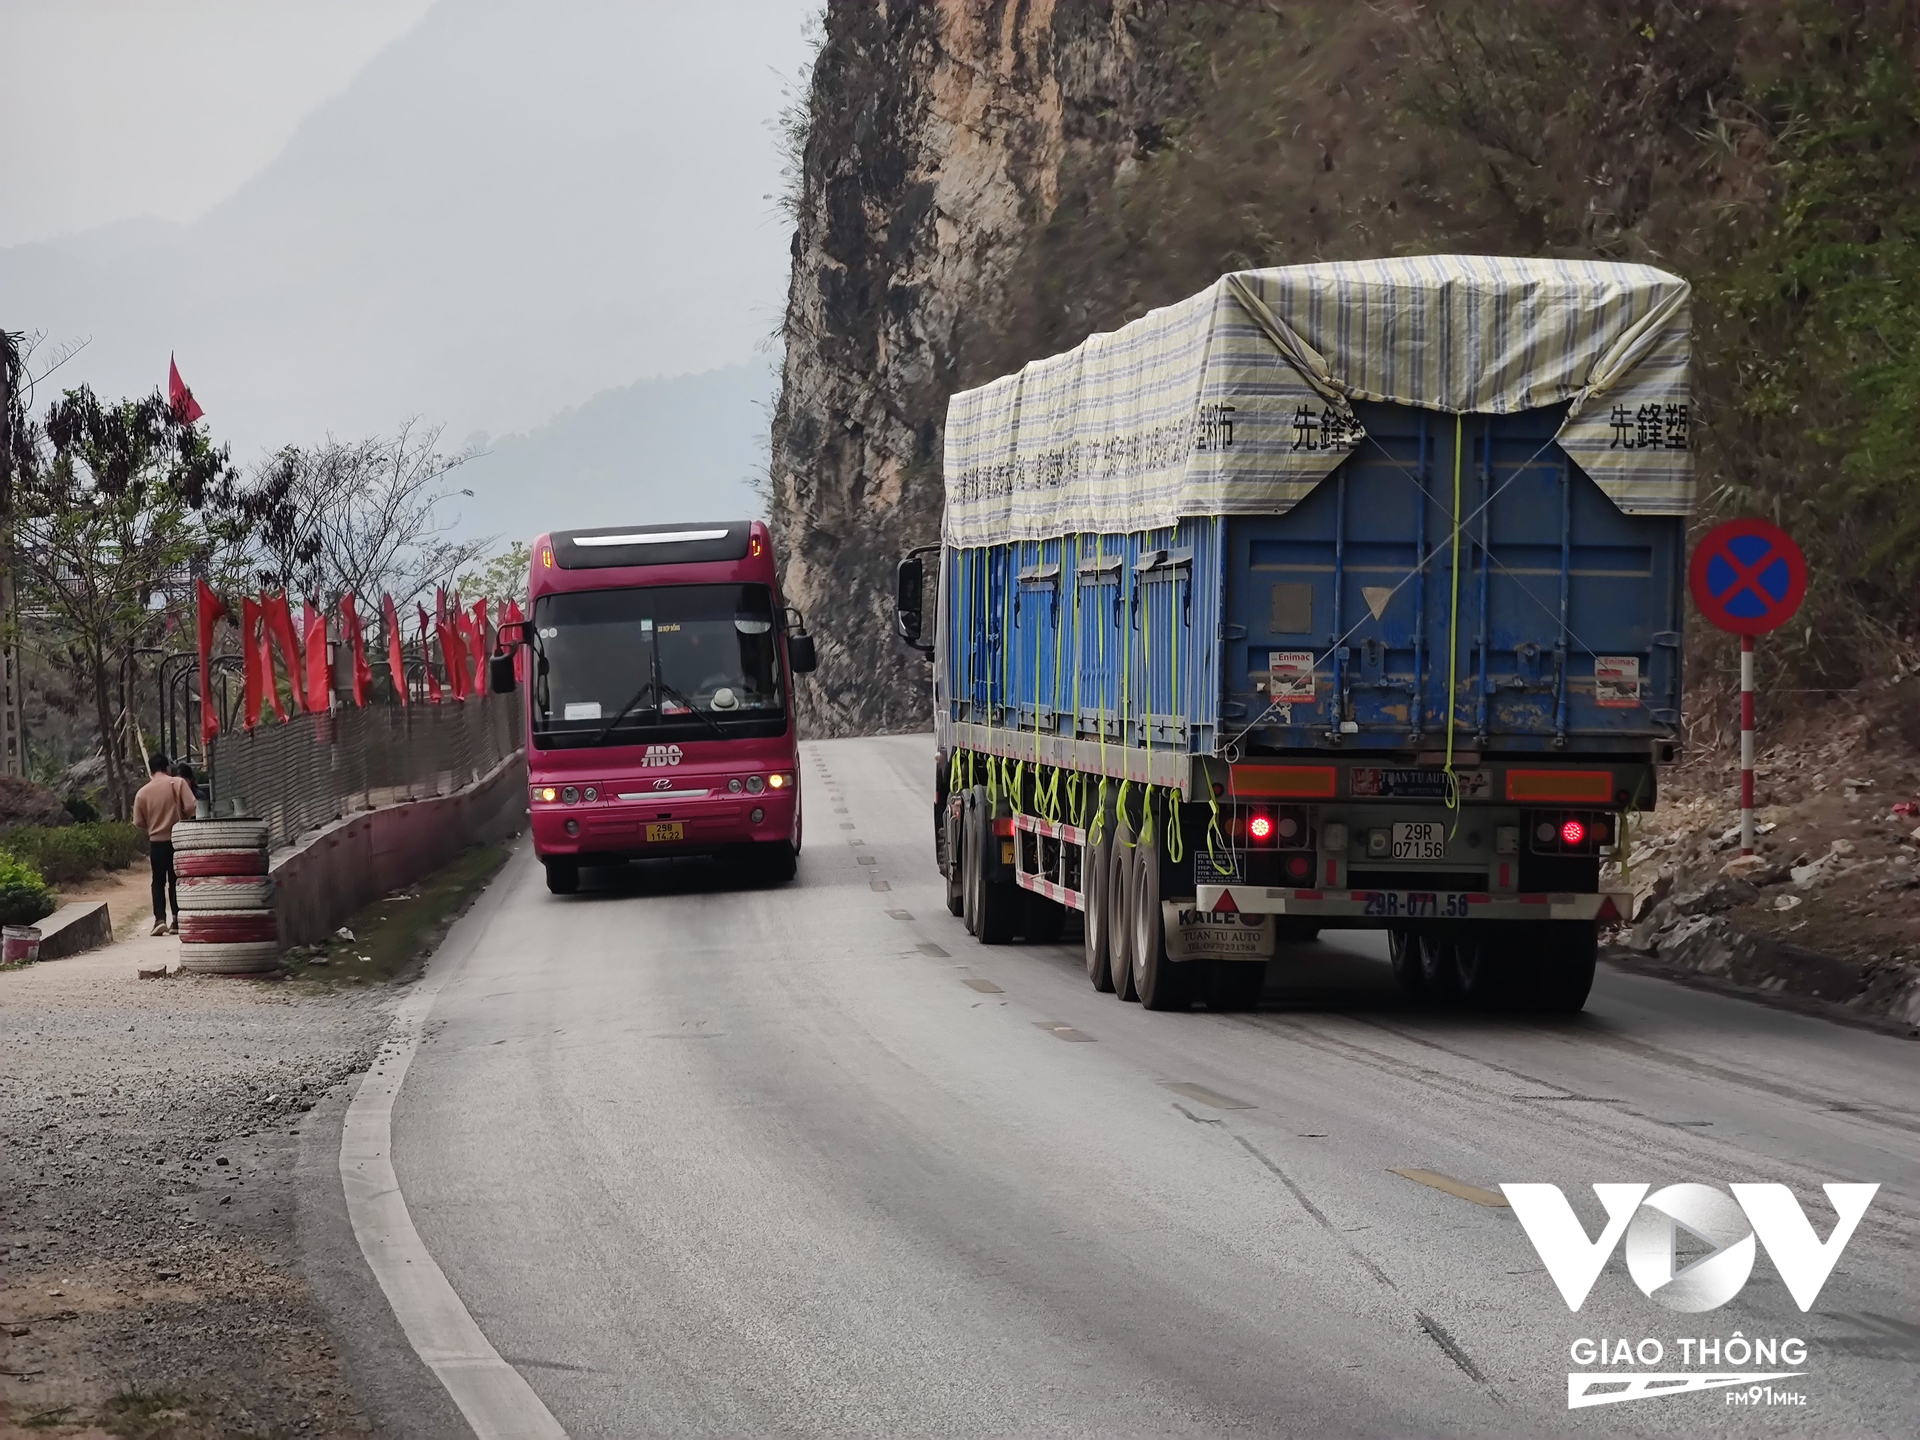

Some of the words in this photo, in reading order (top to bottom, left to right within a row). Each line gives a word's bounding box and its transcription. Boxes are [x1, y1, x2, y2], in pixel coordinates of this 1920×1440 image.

[1278, 653, 1310, 661] Enimac
[1604, 657, 1635, 666] Enimac
[641, 745, 683, 767] ABC
[1410, 773, 1424, 783] TU
[656, 823, 673, 832] 29B
[1405, 824, 1432, 840] 29R
[651, 832, 680, 841] 114.22
[1393, 842, 1442, 858] 071.56
[1364, 892, 1469, 917] 29R-071.56
[1183, 931, 1211, 941] TUAN
[1214, 931, 1228, 941] TU
[1232, 932, 1260, 942] AUTO
